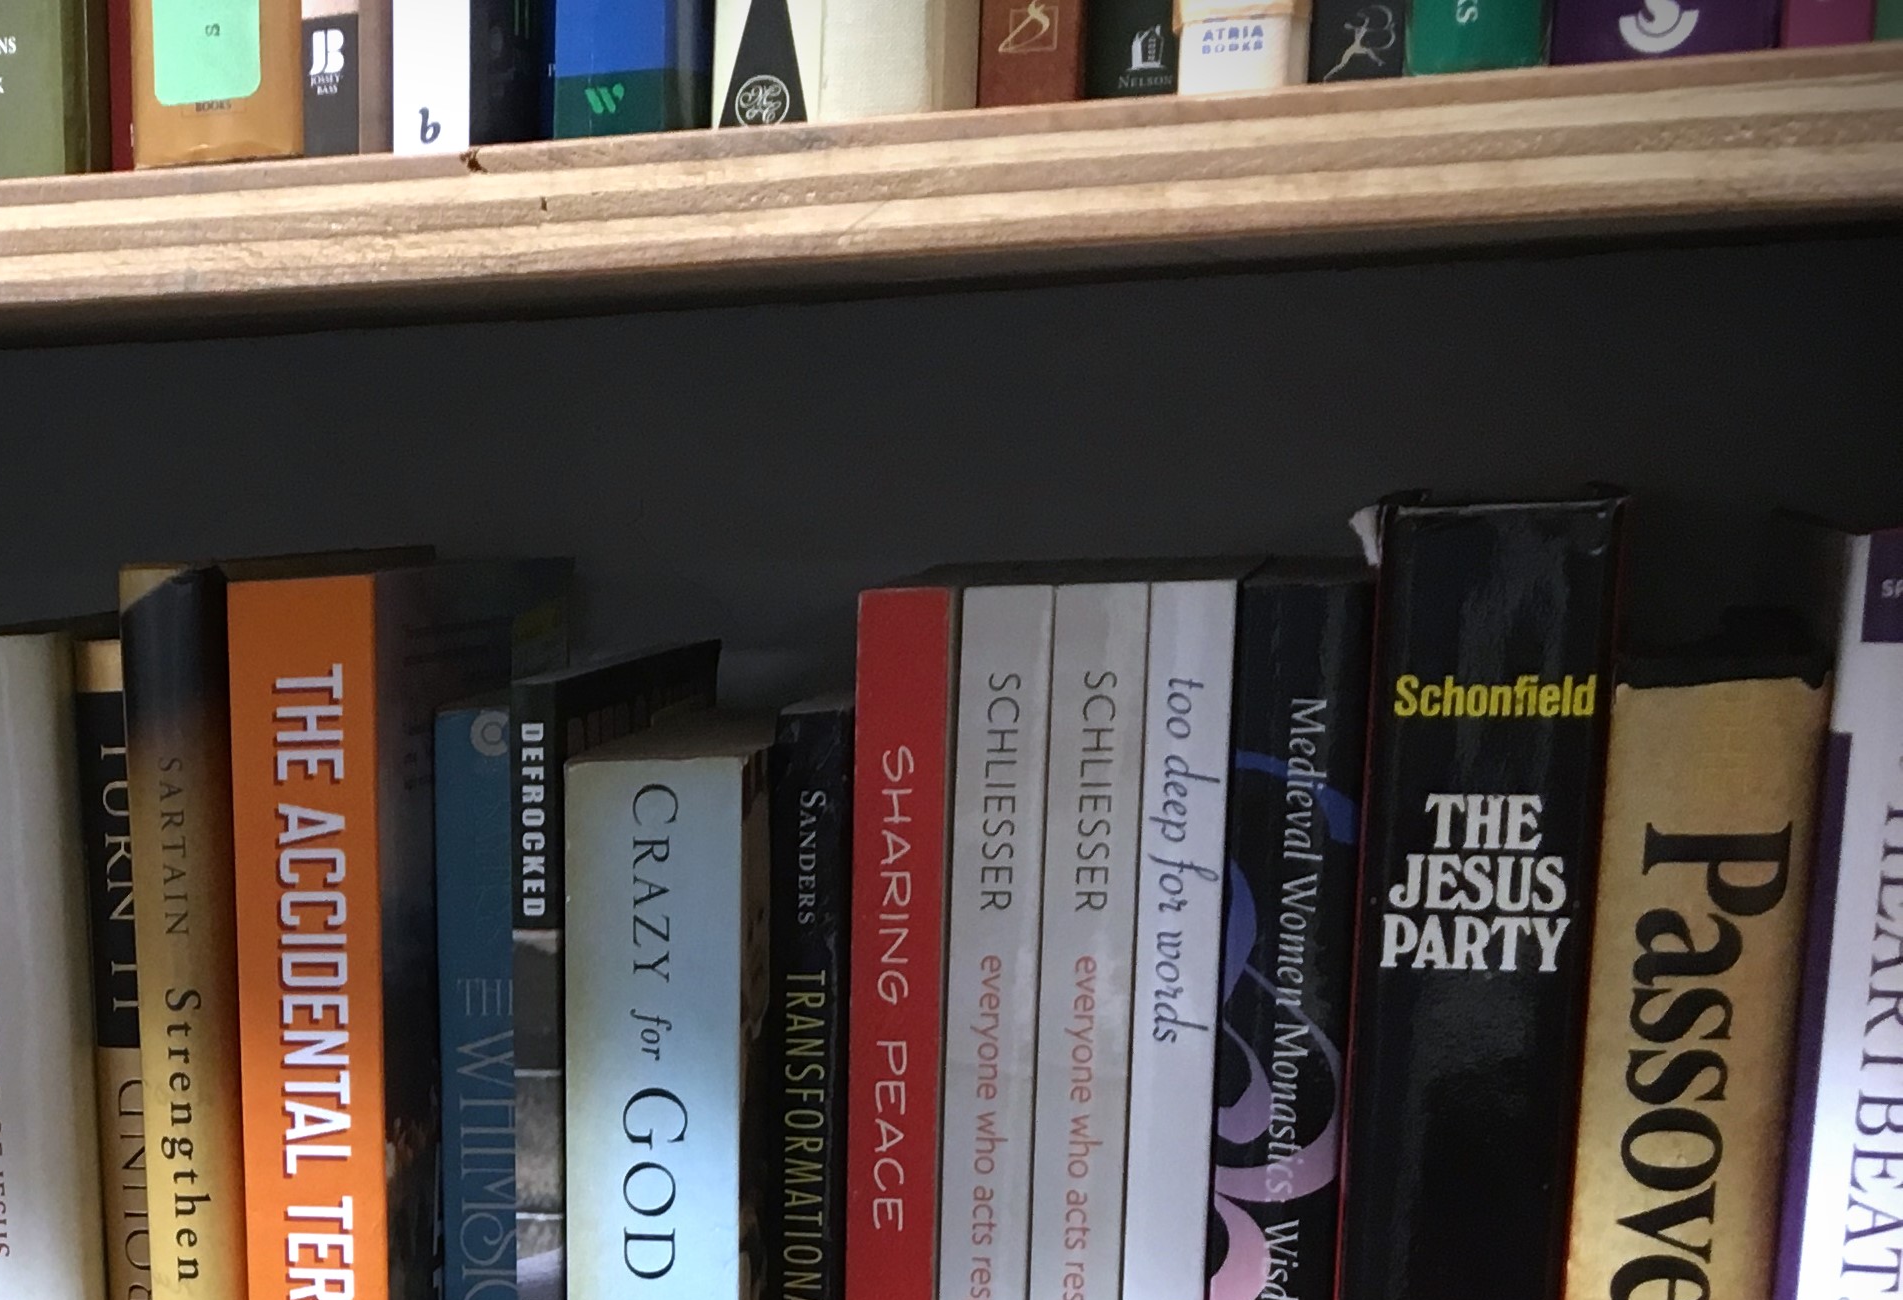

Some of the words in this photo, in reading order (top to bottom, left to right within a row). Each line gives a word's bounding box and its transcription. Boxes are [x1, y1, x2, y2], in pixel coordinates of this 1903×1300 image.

[1201, 40, 1264, 54] BOOKS
[1202, 25, 1264, 41] ATRIA
[418, 106, 441, 145] b
[274, 663, 345, 782] THE
[1395, 675, 1596, 718] Schonfield
[159, 756, 190, 936] SARTAIN
[520, 722, 545, 917] DEFROCKED
[980, 673, 1021, 912] SCHLIESSER
[1283, 699, 1327, 862] Medieval
[1425, 793, 1543, 850] THE
[632, 783, 679, 983] CRAZY
[876, 745, 914, 1005] SHARING
[1275, 873, 1317, 1020] Women
[1381, 916, 1570, 972] PARTY
[1389, 854, 1567, 912] JESUS
[278, 803, 352, 1175] ACCIDENTAL
[970, 954, 1002, 1100] everyone
[1153, 930, 1209, 1045] words
[161, 987, 212, 1281] Strengthen
[622, 1088, 688, 1281] GOD
[872, 1041, 907, 1231] PEACE
